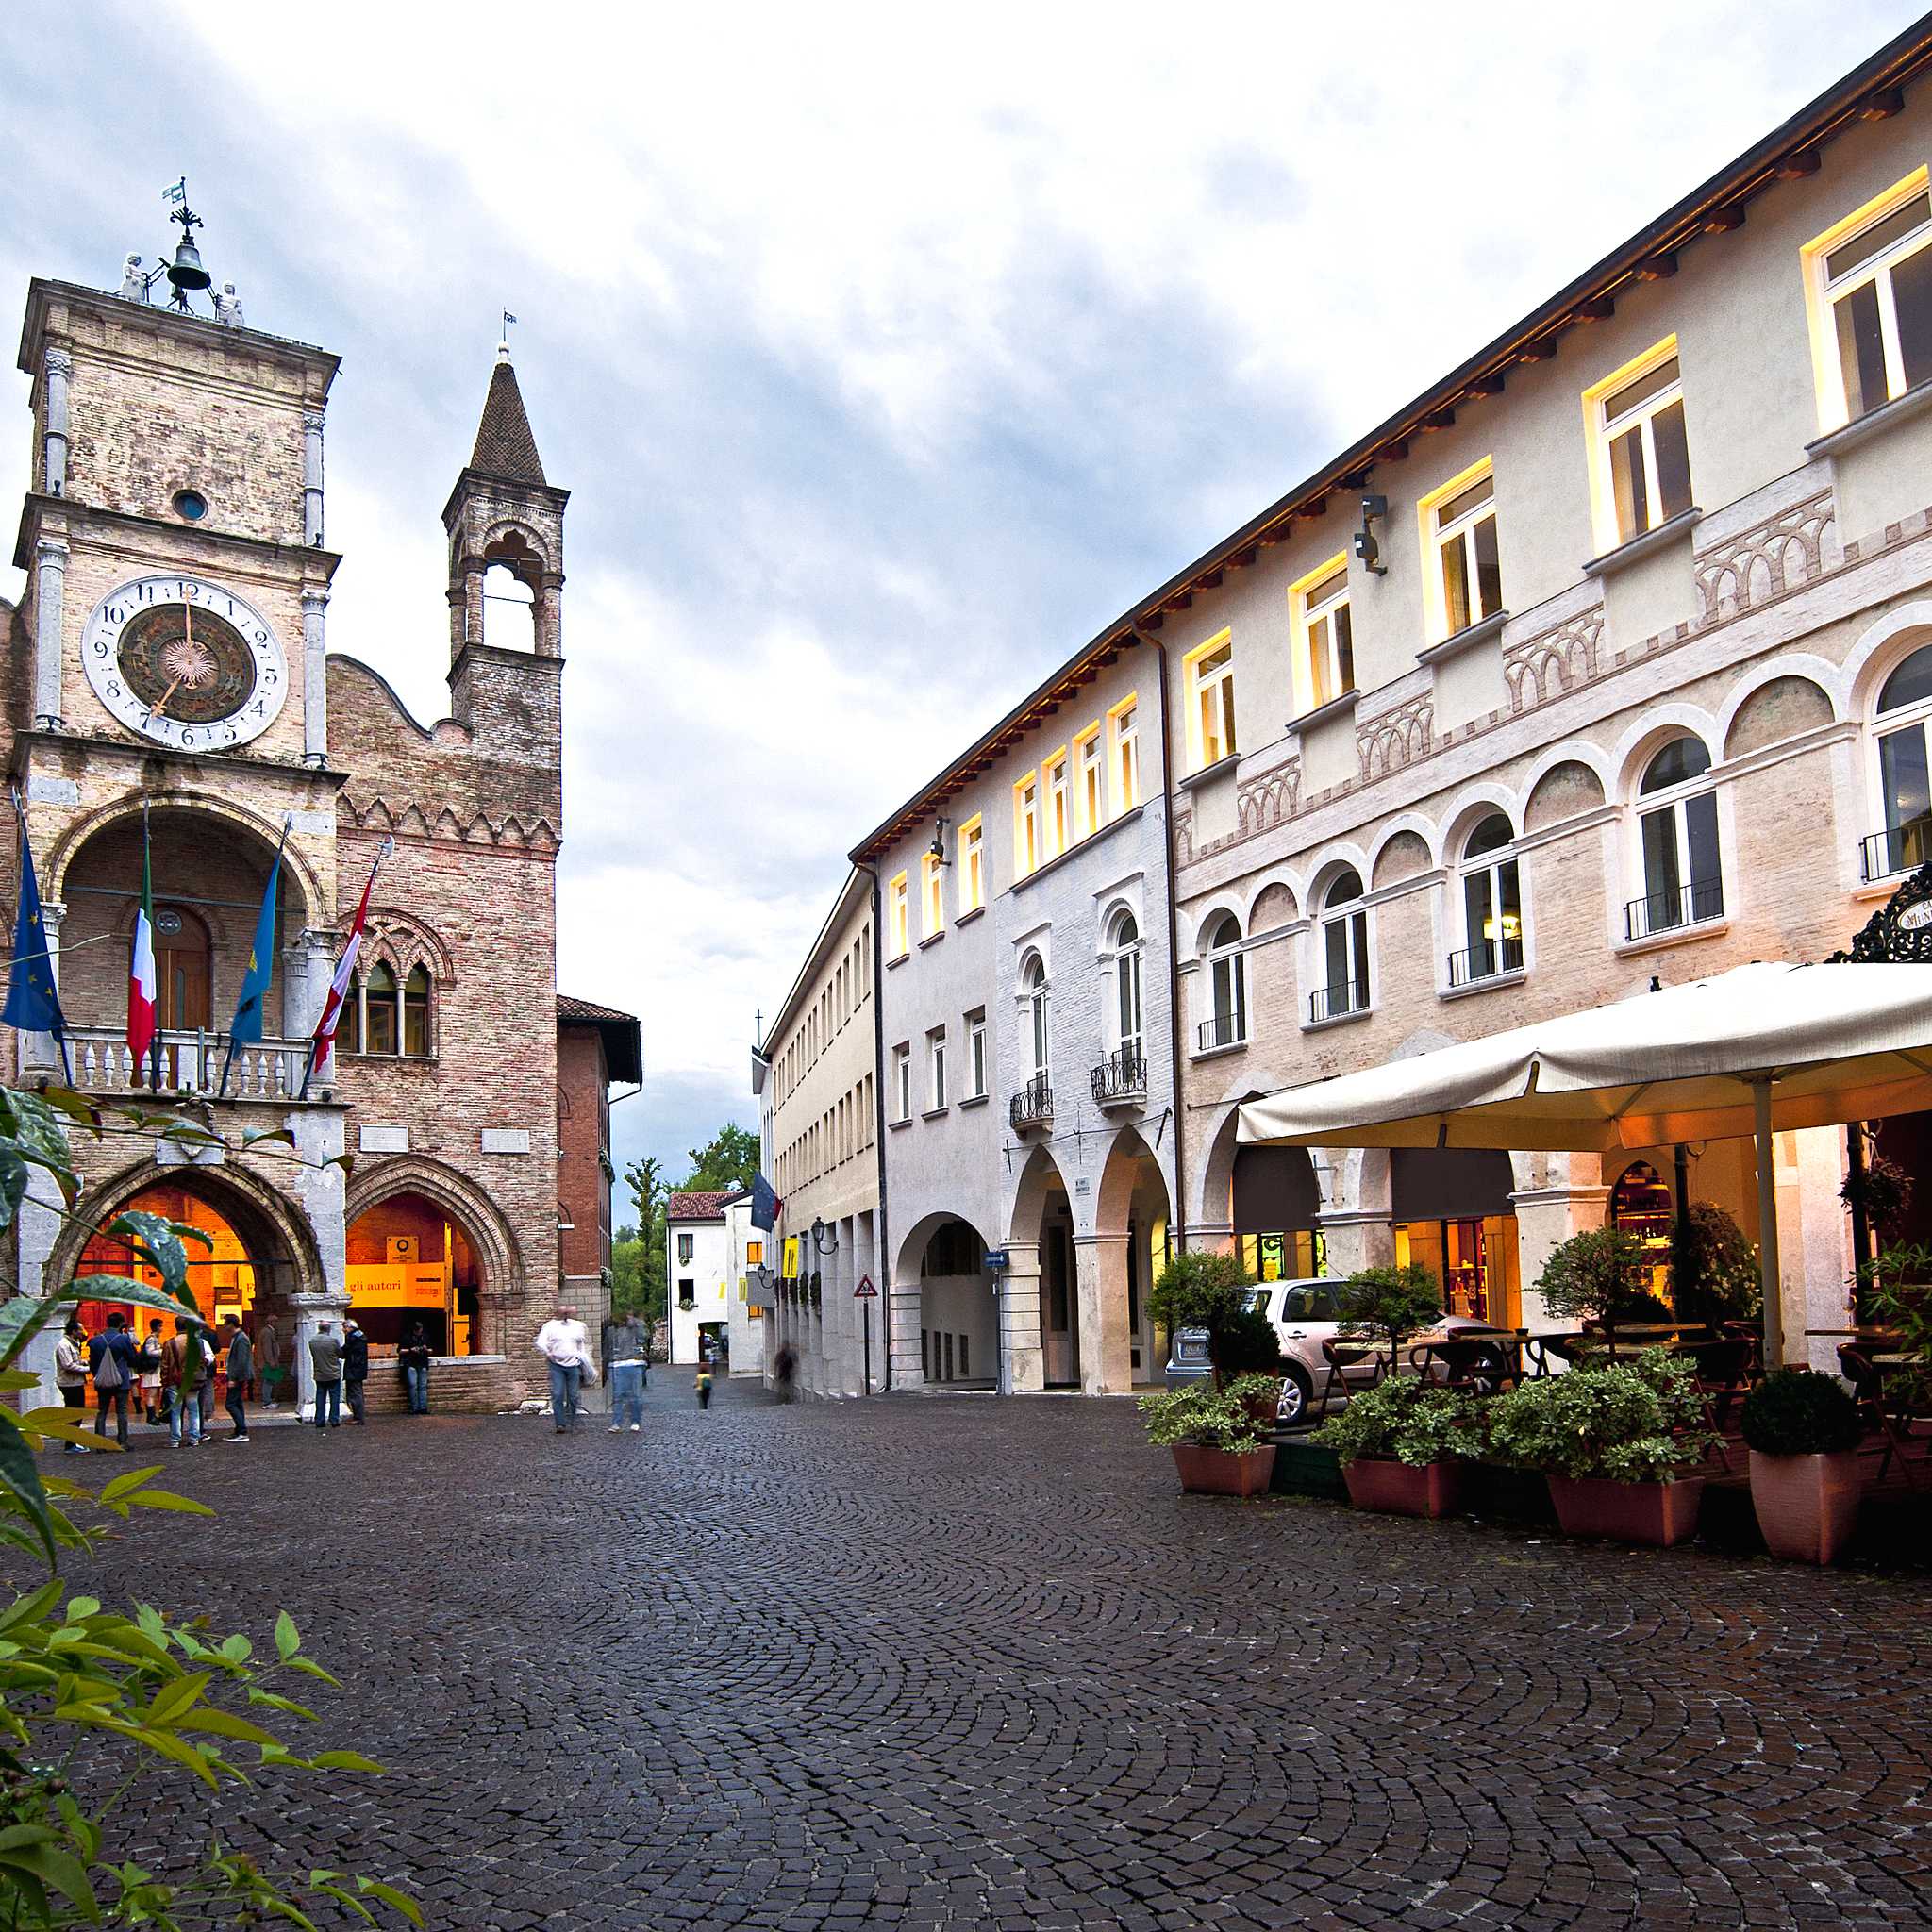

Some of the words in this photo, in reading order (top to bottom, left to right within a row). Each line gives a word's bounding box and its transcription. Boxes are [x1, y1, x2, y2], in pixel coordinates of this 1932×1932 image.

[135, 583, 154, 603] 11
[177, 581, 200, 601] 12
[102, 604, 125, 625] 10
[226, 600, 235, 617] 1
[255, 630, 268, 649] 2
[93, 641, 108, 658] 9
[106, 679, 121, 698] 8
[250, 699, 265, 718] 4
[139, 711, 150, 730] 7
[180, 728, 195, 746] 6
[225, 724, 237, 741] 5
[350, 1280, 363, 1293] gli
[367, 1279, 401, 1291] autori
